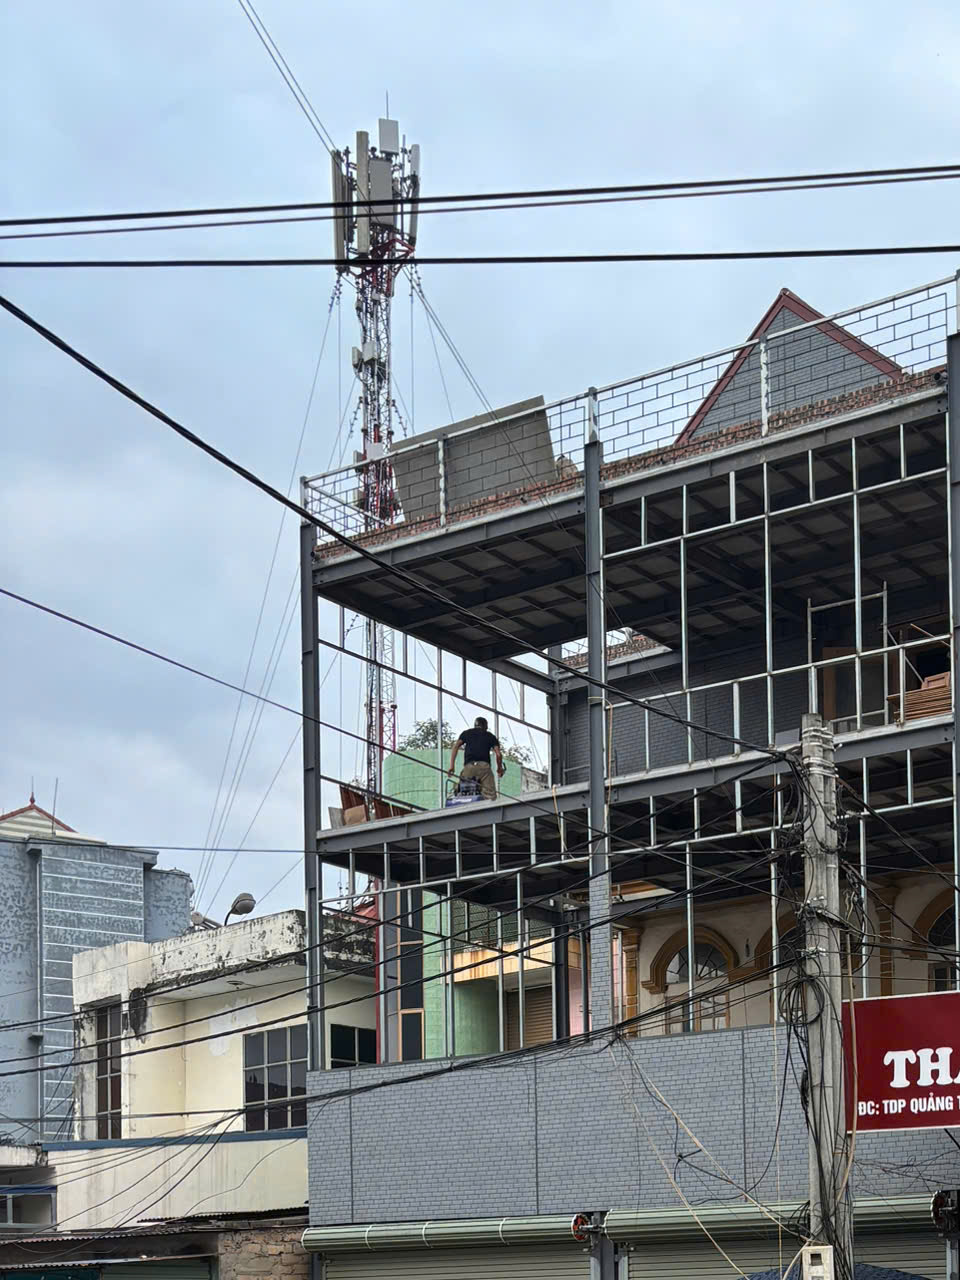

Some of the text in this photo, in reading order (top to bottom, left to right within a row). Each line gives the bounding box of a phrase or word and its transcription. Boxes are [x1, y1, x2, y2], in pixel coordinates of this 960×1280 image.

[858, 1101, 880, 1116] ĐC:
[882, 1098, 907, 1114] TDP
[910, 1092, 954, 1113] QUẢNG
